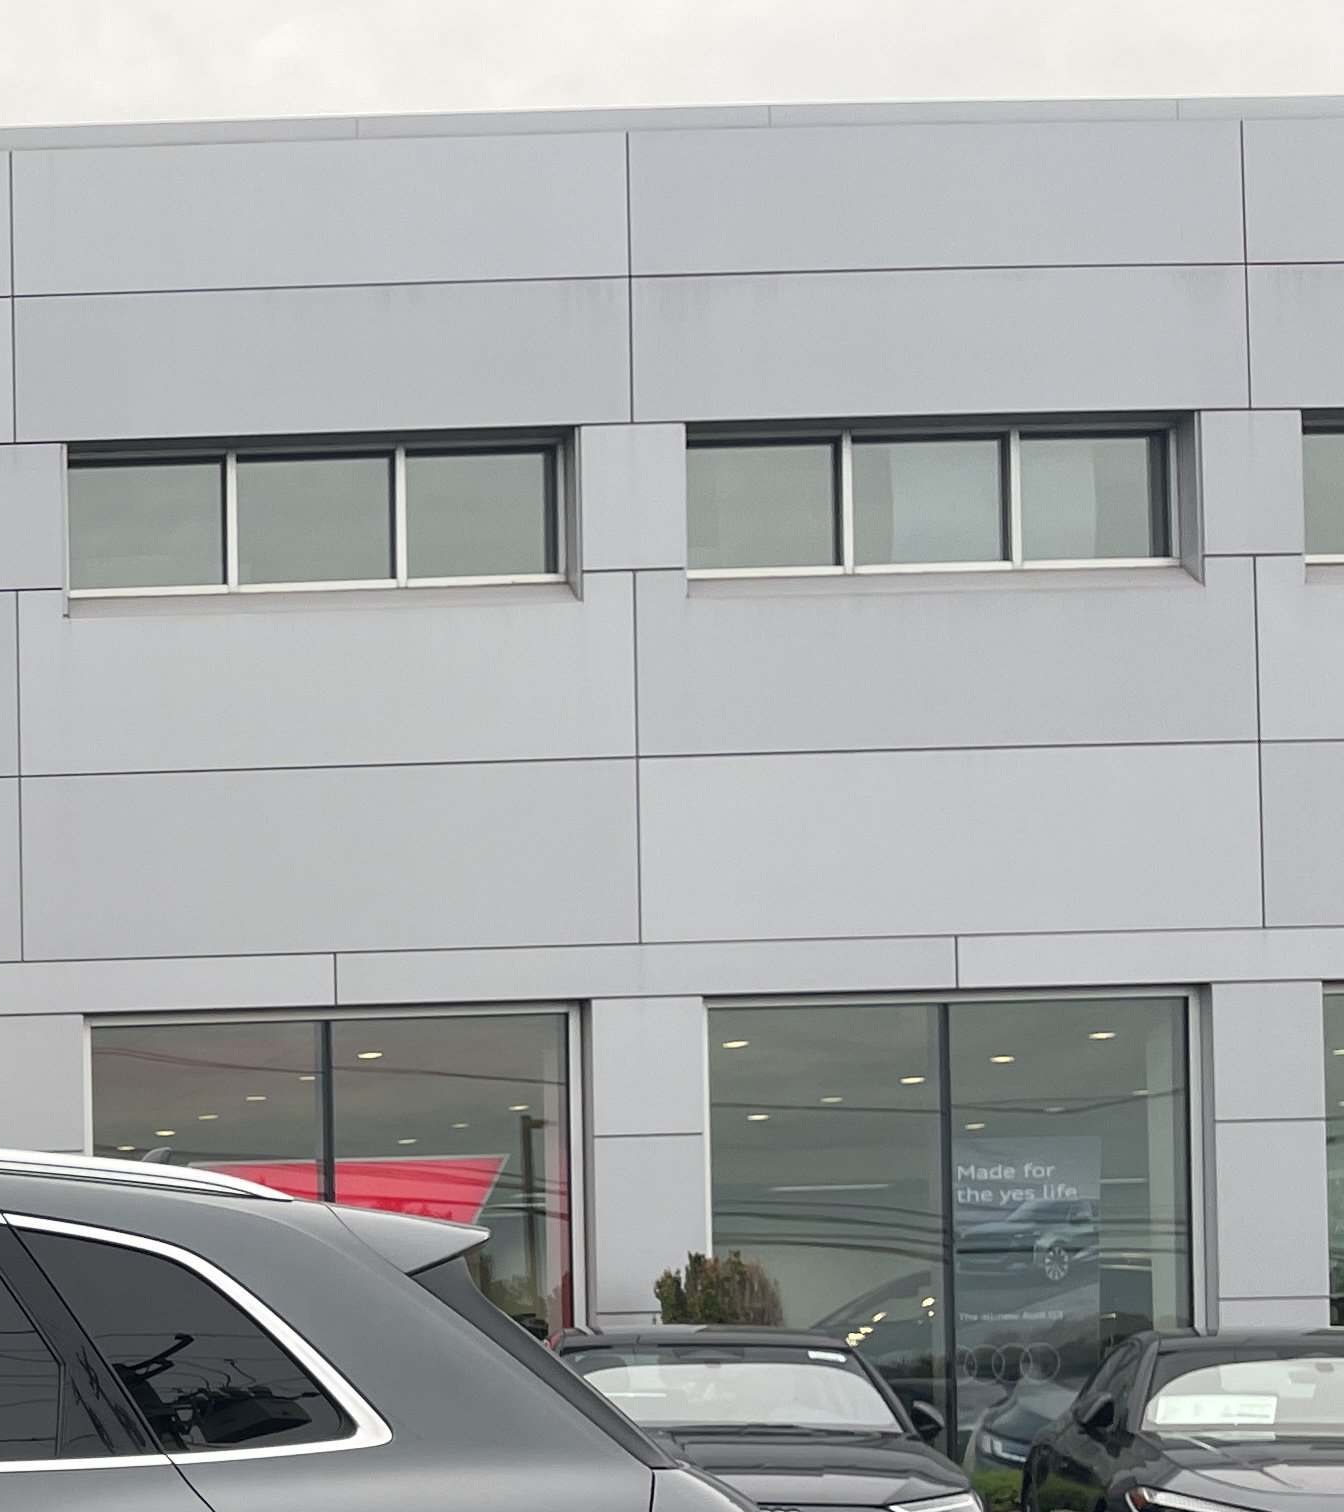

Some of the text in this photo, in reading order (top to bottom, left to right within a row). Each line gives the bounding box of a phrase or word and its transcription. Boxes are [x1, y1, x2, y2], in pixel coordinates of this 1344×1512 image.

[957, 1162, 1055, 1180] Made for
[957, 1184, 1079, 1205] the yes life
